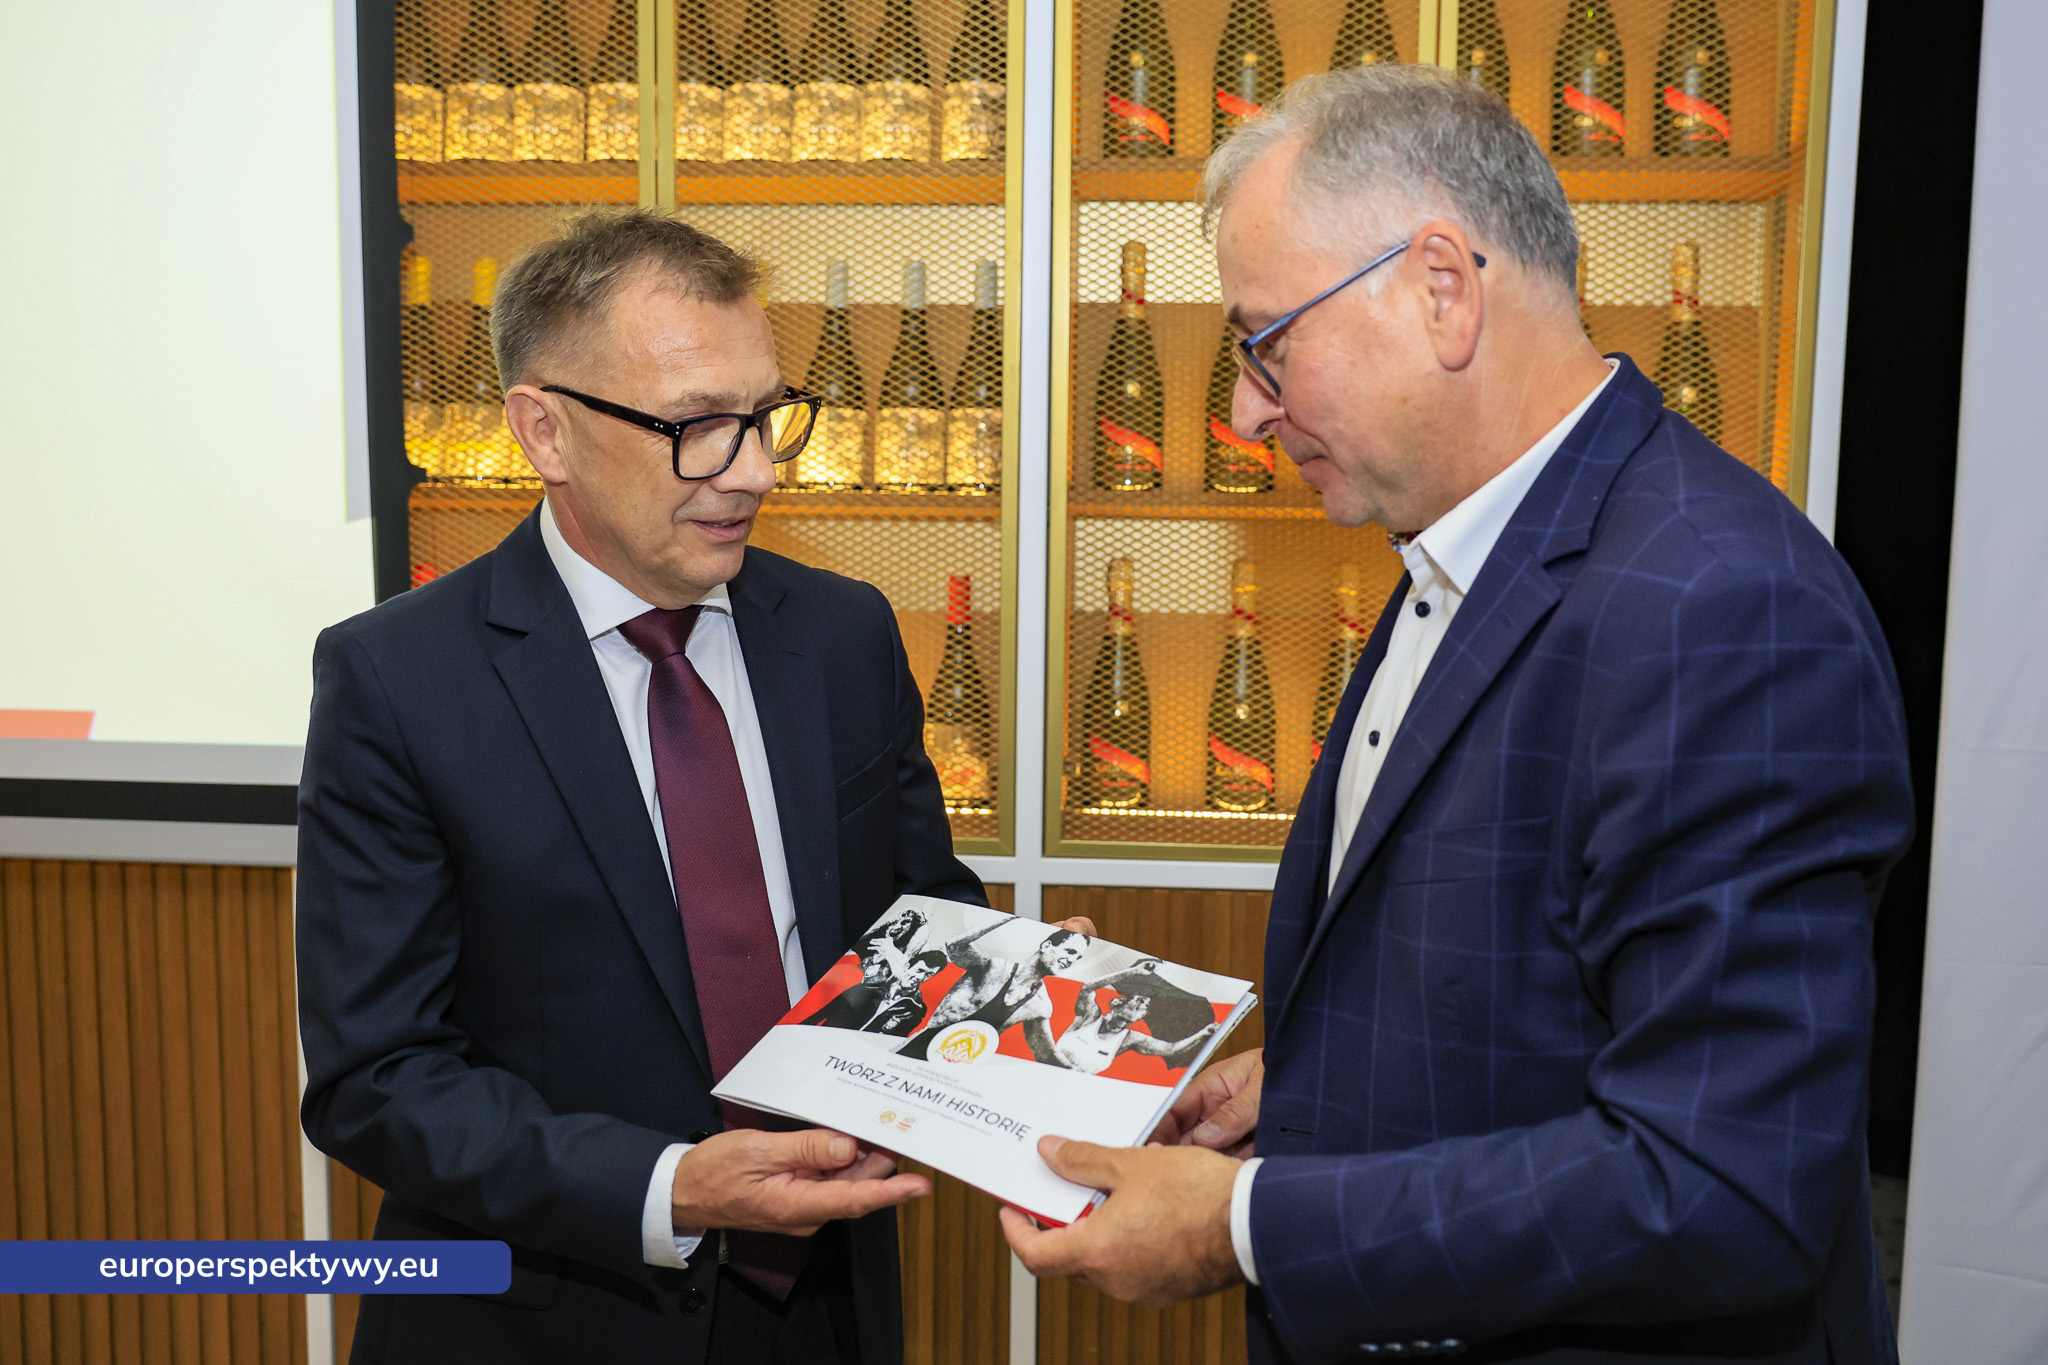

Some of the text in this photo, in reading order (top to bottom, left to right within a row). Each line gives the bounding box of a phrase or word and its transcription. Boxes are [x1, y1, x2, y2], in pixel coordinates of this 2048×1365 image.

[825, 1055, 885, 1084] TWÓRZ
[883, 1075, 899, 1088] Z
[898, 1080, 946, 1105] NAMI
[946, 1097, 1032, 1141] HISTORIĘ
